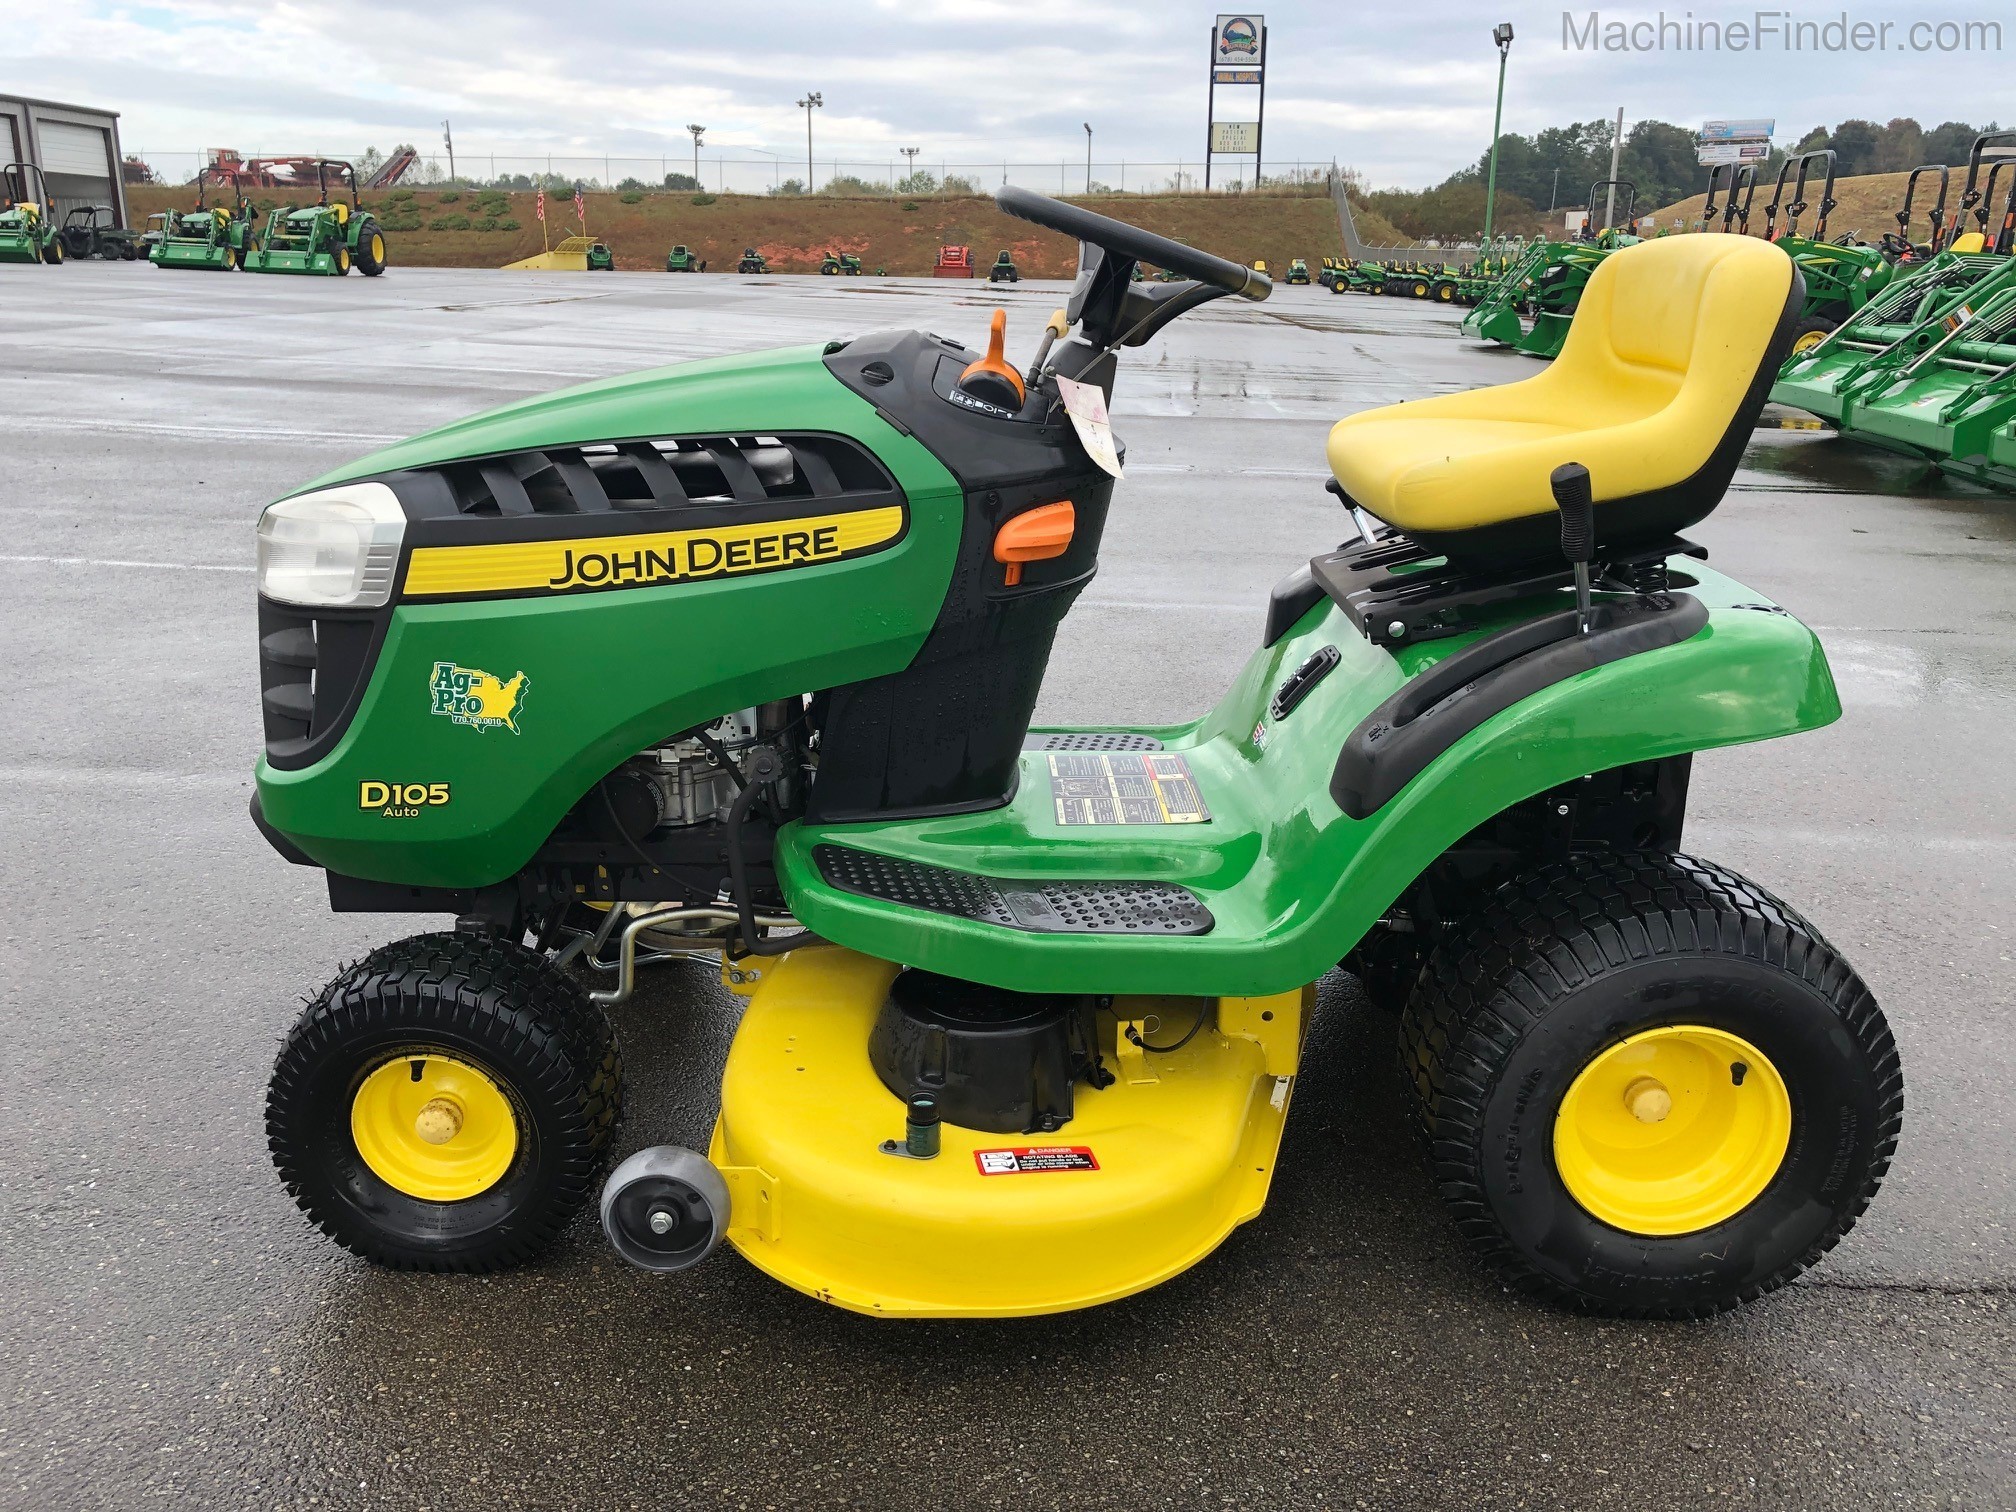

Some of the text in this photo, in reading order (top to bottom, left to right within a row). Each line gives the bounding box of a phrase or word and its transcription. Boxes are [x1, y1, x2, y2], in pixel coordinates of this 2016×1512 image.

[1217, 72, 1259, 82] ANIMAL HOSPITAL
[550, 526, 838, 585] JOHN DEERE
[433, 664, 481, 695] Ag-
[433, 689, 483, 714] Pro
[360, 782, 450, 808] D105
[383, 806, 419, 817] Auto
